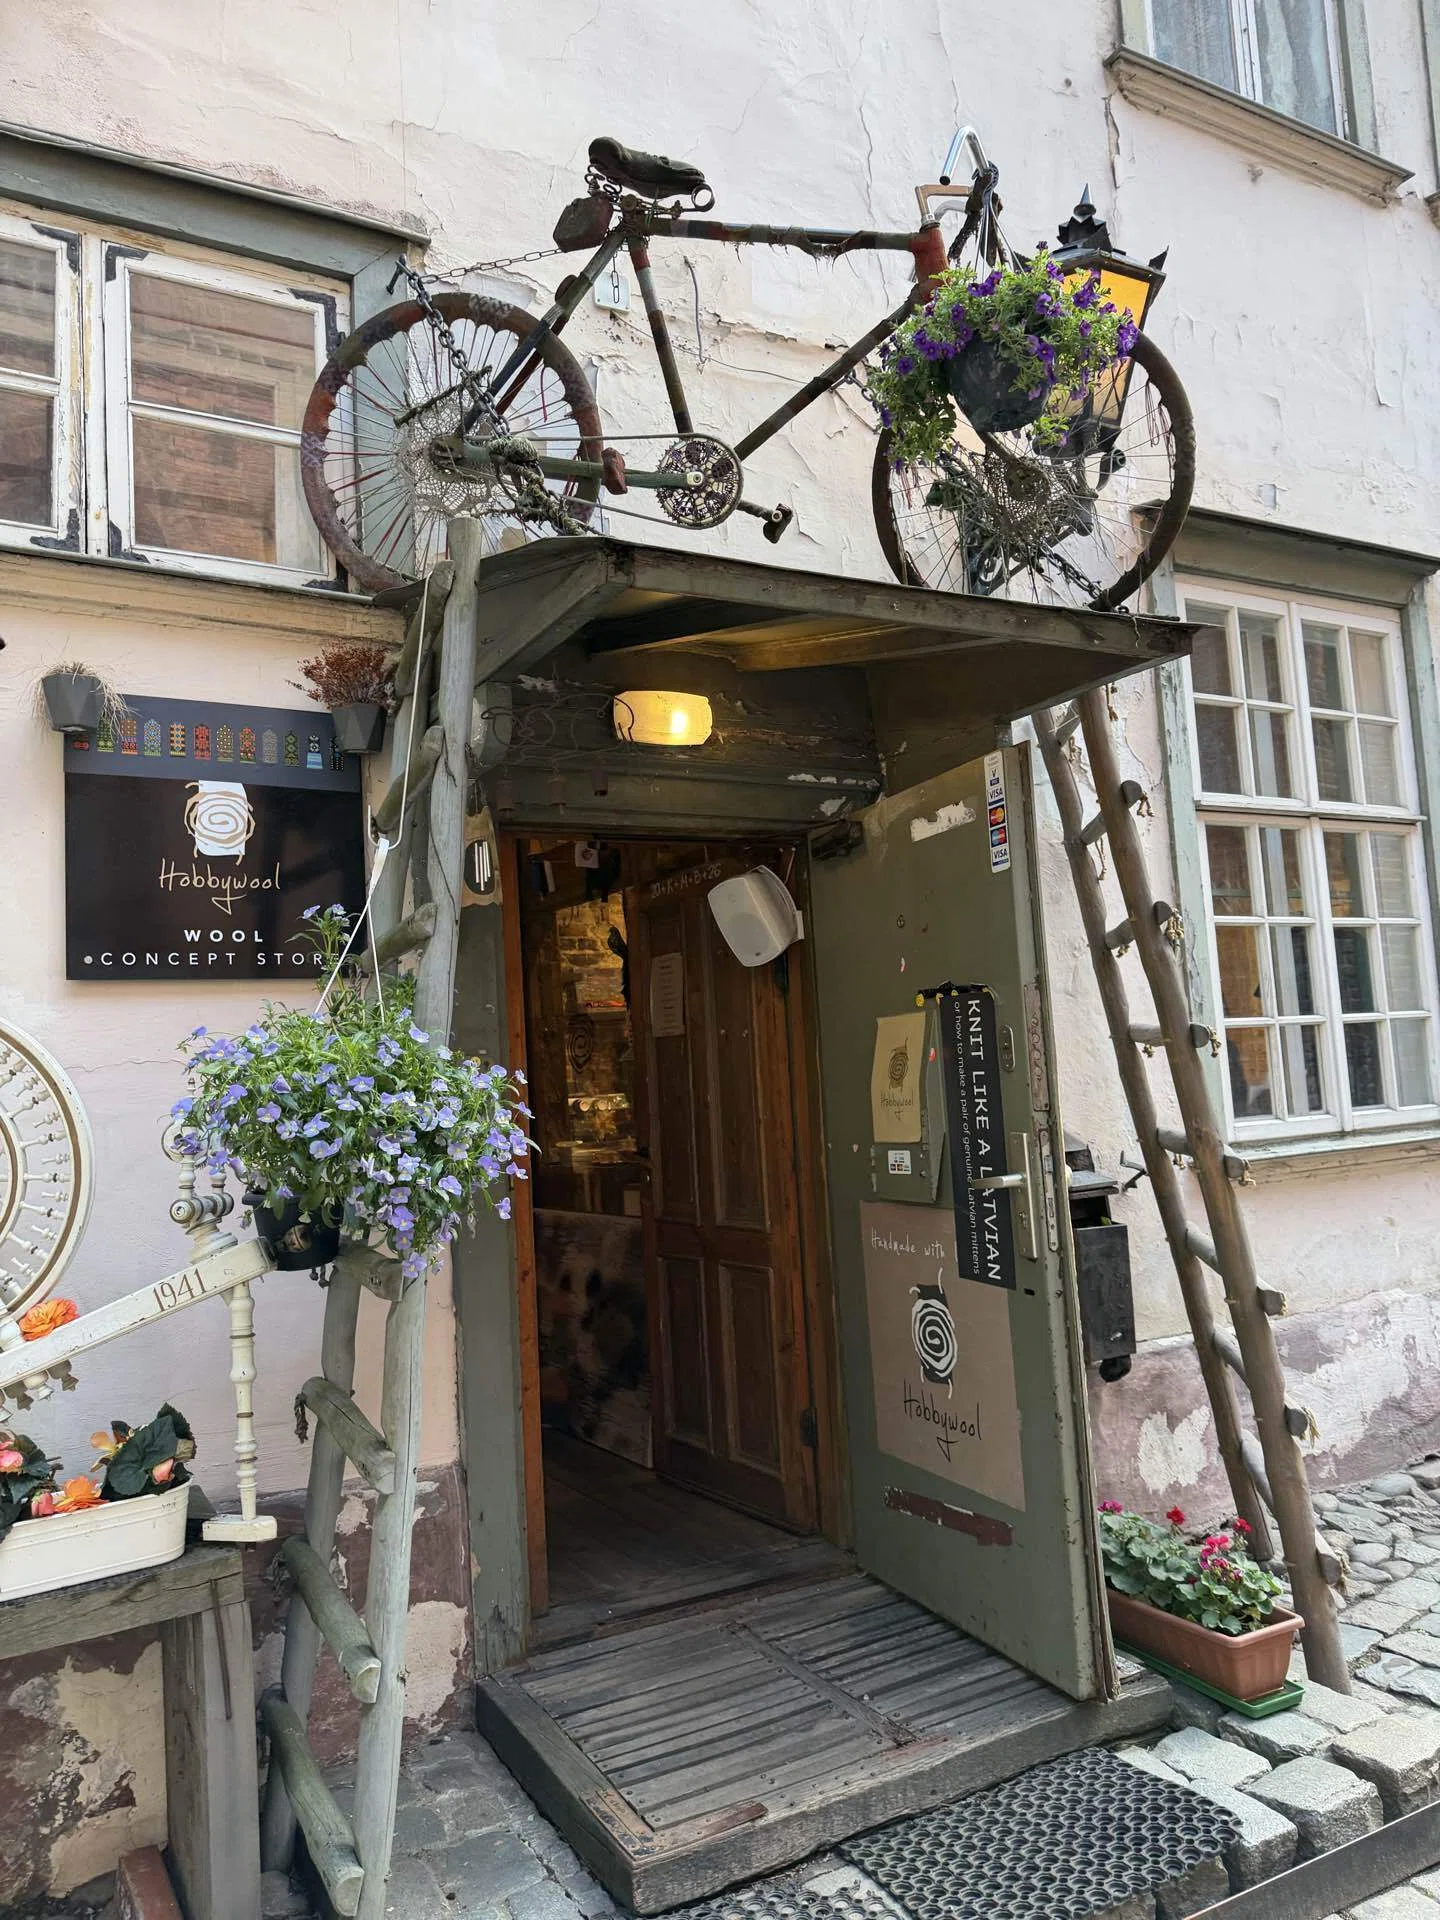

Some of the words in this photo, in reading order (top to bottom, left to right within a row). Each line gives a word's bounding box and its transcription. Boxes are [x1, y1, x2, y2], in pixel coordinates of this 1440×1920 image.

[989, 786, 1004, 800] VISA
[993, 848, 1008, 860] VISA
[158, 857, 281, 916] Hobbywool
[183, 929, 265, 943] WOOL
[100, 952, 235, 967] CONCEPT
[256, 952, 340, 966] STORE
[954, 1001, 961, 1013] or
[954, 1016, 962, 1040] how
[967, 999, 984, 1061] KNIT
[957, 1043, 963, 1055] to
[958, 1057, 967, 1087] make
[960, 1099, 969, 1121] pair
[972, 1071, 990, 1130] LIKE
[962, 1122, 971, 1136] of
[963, 1136, 974, 1184] genuine
[977, 1138, 991, 1156] A
[967, 1187, 976, 1229] Latvian
[871, 1227, 917, 1256] Handmade
[923, 1240, 946, 1259] with
[970, 1231, 980, 1274] mittens
[152, 1267, 209, 1313] 1941
[903, 1379, 982, 1462] Hobbywool
